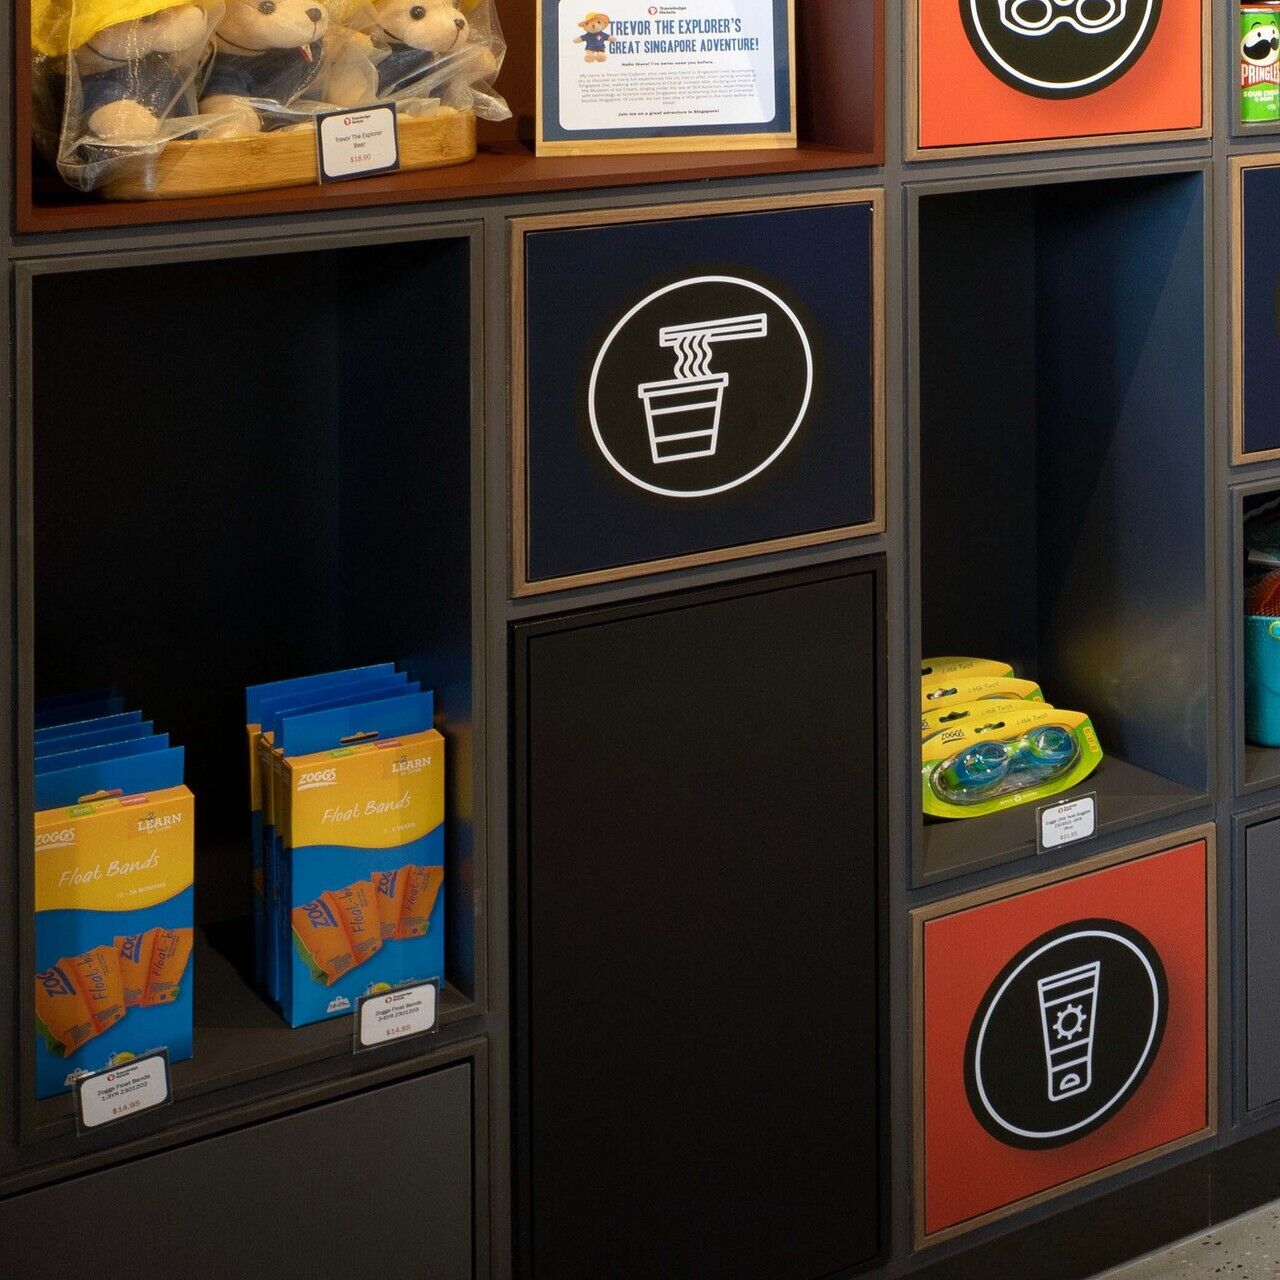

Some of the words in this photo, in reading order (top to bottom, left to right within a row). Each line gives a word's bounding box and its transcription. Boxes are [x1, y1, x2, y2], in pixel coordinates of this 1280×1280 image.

[609, 20, 652, 36] TREVOR
[654, 20, 675, 35] THE
[678, 18, 742, 36] EXPLORER'S
[609, 40, 640, 55] GREAT
[644, 39, 697, 54] SINGAPORE
[700, 37, 760, 53] ADVENTURE!
[942, 729, 965, 740] ZOGGS
[392, 757, 431, 773] LEARN
[297, 768, 337, 783] ZOGGS
[322, 806, 360, 824] Float
[365, 790, 412, 816] Bands
[137, 813, 182, 831] LEARN
[35, 828, 76, 846] ZOGGS
[58, 863, 102, 888] Float
[106, 848, 160, 877] Bands
[386, 1024, 411, 1036] $14.95
[112, 1100, 141, 1115] $14.95
